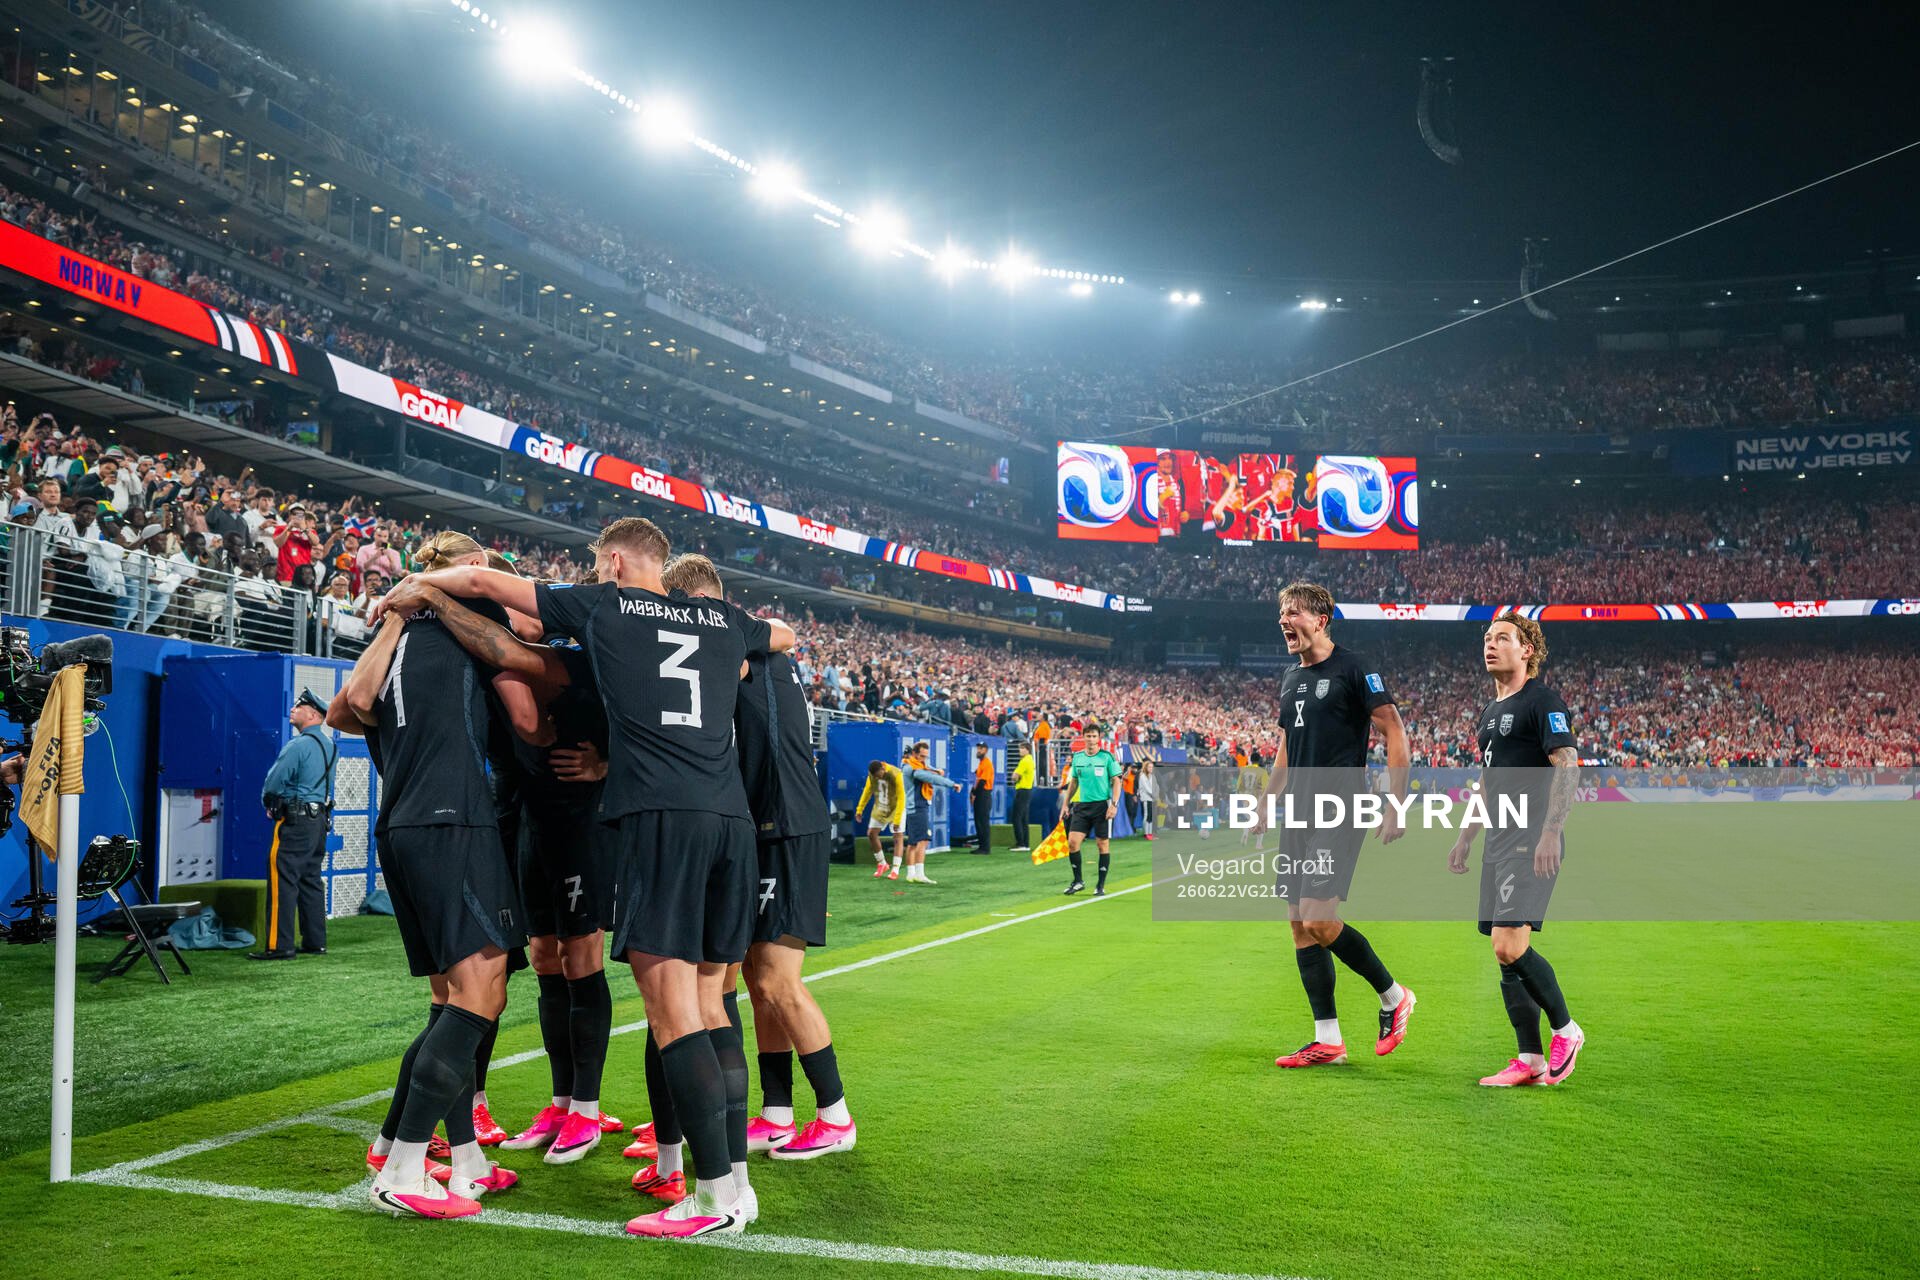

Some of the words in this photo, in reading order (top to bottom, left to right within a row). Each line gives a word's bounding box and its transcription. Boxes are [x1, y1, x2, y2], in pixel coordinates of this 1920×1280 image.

[401, 393, 463, 432] GOAL
[525, 437, 580, 471] GOAL
[1736, 437, 1810, 454] NEW
[1818, 431, 1912, 450] YORK
[1737, 457, 1797, 472] NEW
[1804, 450, 1912, 468] JERSEY
[631, 472, 675, 502] GOAL
[720, 502, 761, 526] GOAL
[802, 524, 837, 545] GOAL
[619, 597, 694, 624] VASSBAKK
[697, 608, 729, 629] AJER
[1383, 608, 1430, 619] GOAL
[1780, 605, 1830, 617] GOAL
[658, 629, 702, 729] 3
[1295, 700, 1305, 727] 8
[39, 737, 60, 771] FIFA
[1484, 739, 1493, 767] 6
[565, 874, 584, 912] 7
[759, 878, 776, 915] 7
[1500, 874, 1515, 903] 6
